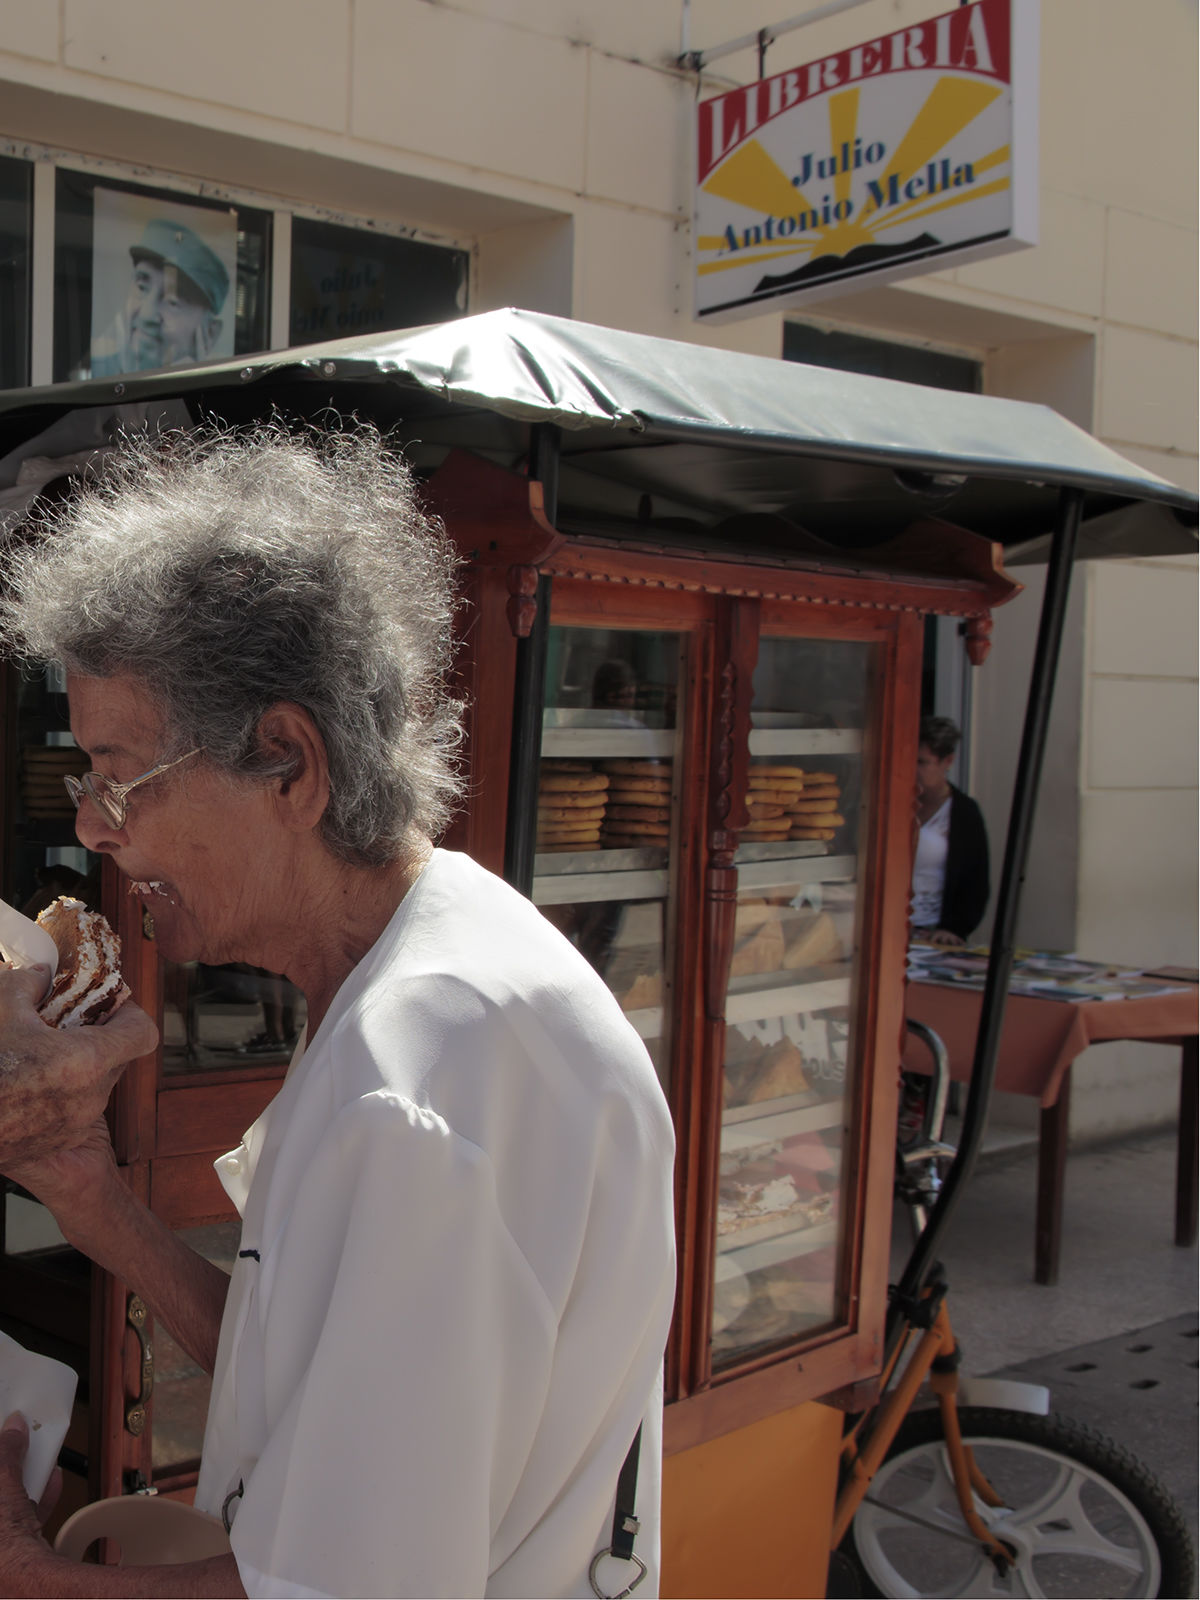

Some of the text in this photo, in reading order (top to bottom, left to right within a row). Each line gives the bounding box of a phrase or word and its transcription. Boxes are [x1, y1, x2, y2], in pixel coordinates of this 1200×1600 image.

[708, 3, 998, 171] LIBRERIA
[718, 158, 976, 257] Antonio Mella
[791, 137, 886, 188] Julio
